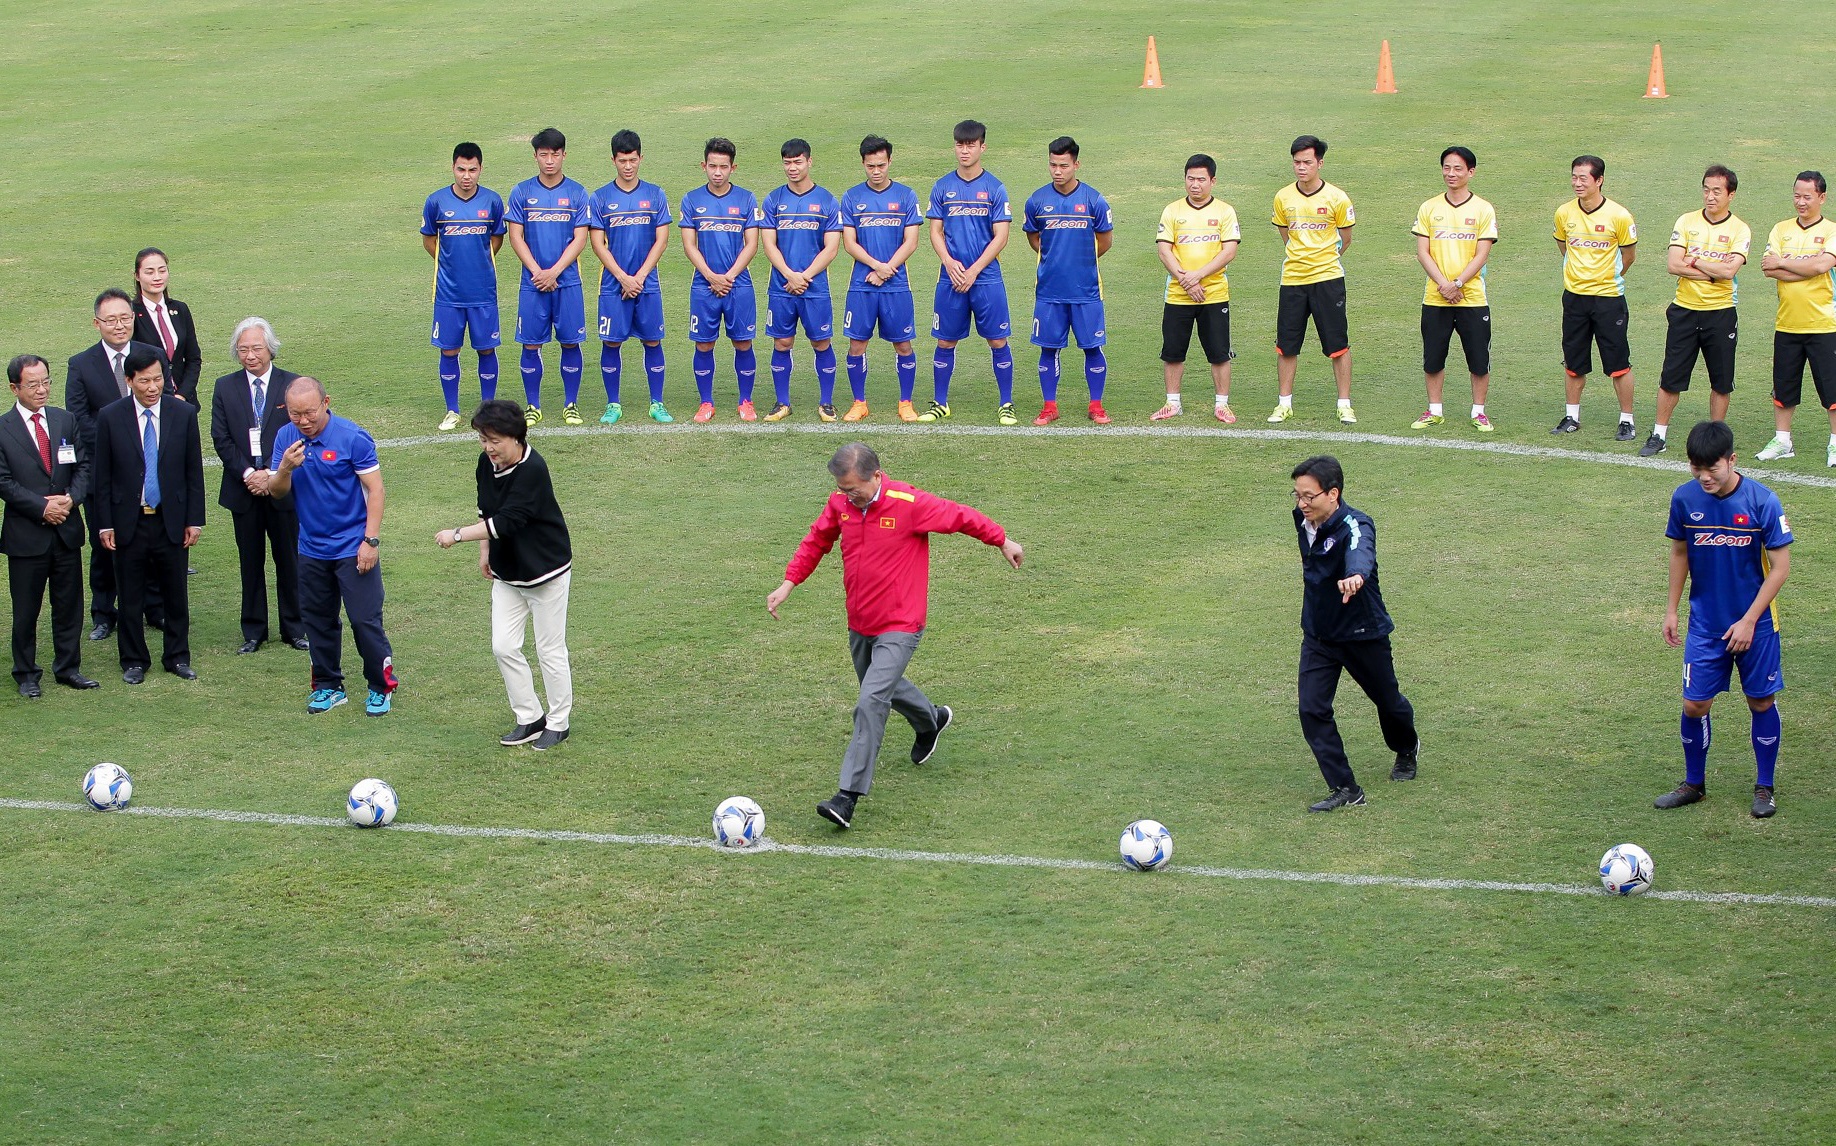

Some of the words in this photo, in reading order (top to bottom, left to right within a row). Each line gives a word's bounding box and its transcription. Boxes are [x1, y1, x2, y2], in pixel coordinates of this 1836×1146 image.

[947, 205, 988, 217] Z.com
[528, 212, 570, 223] Z.com
[610, 216, 651, 228] Z.com
[859, 216, 901, 228] Z.com
[444, 225, 487, 236] Z.com
[698, 221, 742, 233] Z.com
[777, 220, 820, 231] Z.com
[1044, 219, 1088, 230] Z.com
[1289, 221, 1328, 231] Z.com
[1177, 233, 1220, 245] Z.com
[1434, 230, 1477, 241] Z.com
[1568, 237, 1610, 249] Z.com
[599, 316, 611, 335] 21
[1694, 533, 1752, 547] Z.com
